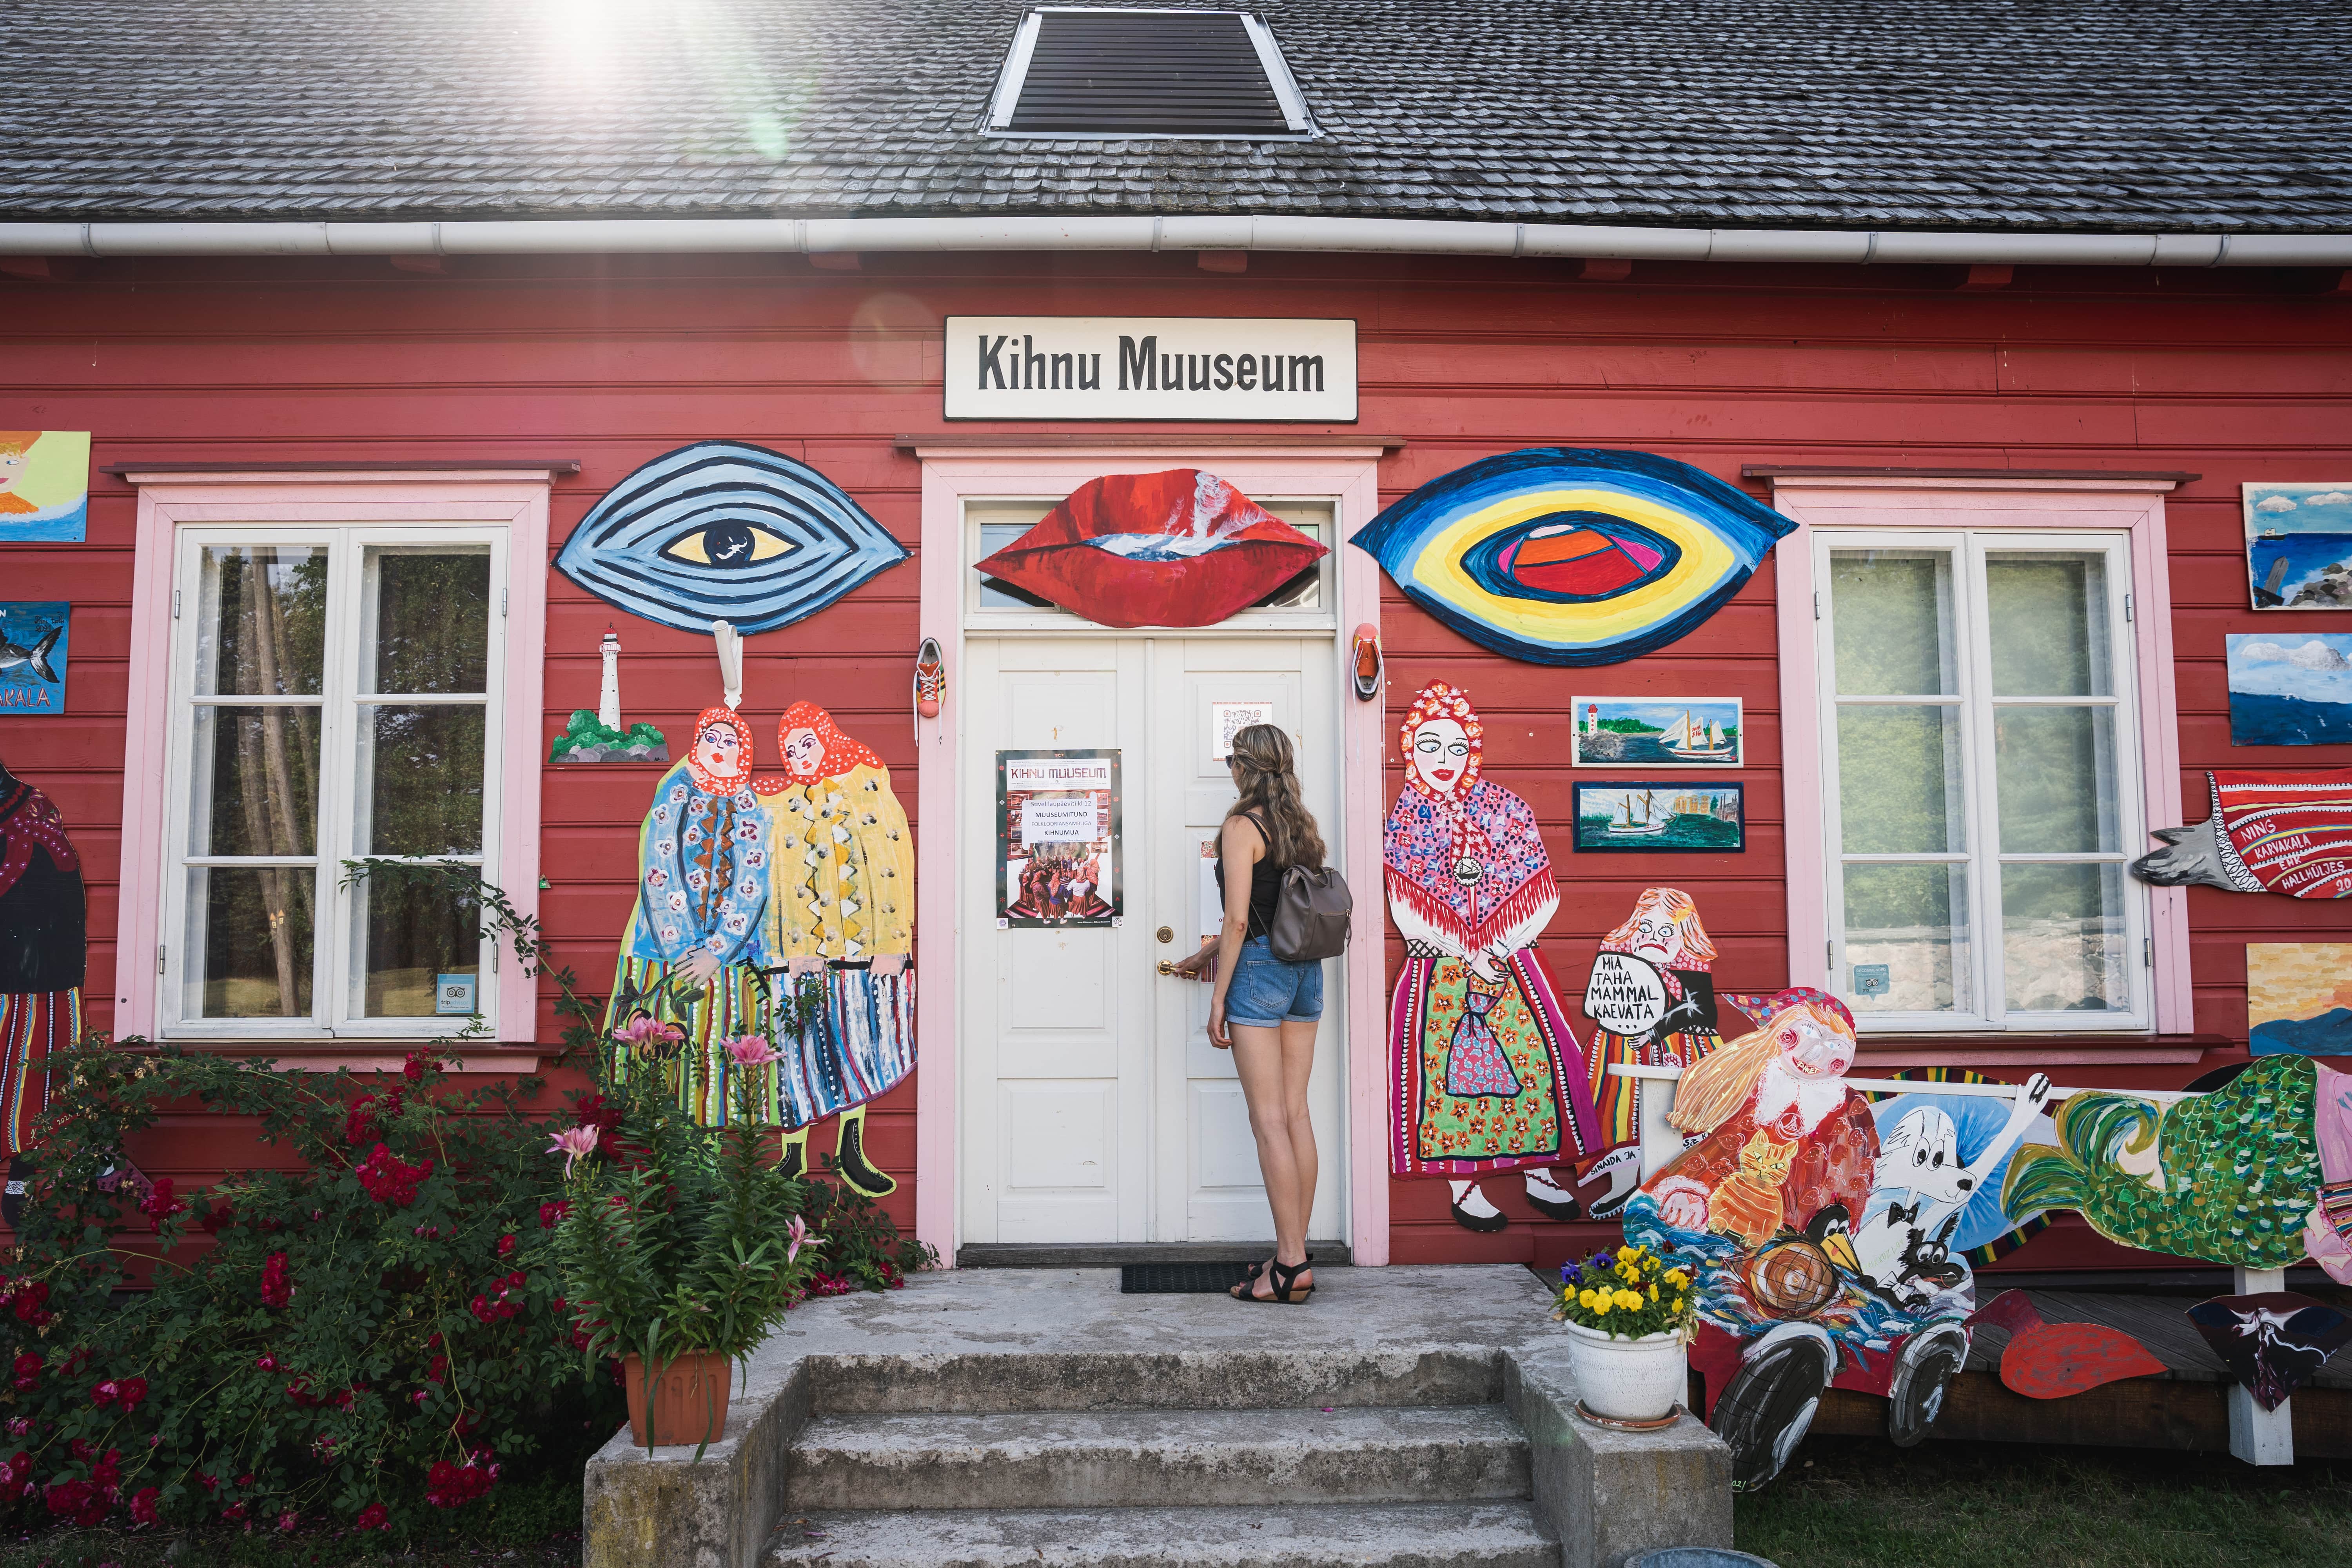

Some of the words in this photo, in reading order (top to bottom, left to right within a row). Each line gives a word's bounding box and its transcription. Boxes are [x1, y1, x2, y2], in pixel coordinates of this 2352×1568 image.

[978, 335, 1101, 390] Kihnu
[1118, 335, 1325, 392] Muuseum
[1011, 768, 1045, 779] KIHNU
[1049, 768, 1107, 779] MUUSEUM
[2240, 819, 2276, 843] NING
[2254, 834, 2311, 860] KARVAKALA
[2279, 855, 2302, 870] EHK
[2282, 861, 2345, 889] HALLHÜLJES
[2336, 877, 2352, 891] 20
[1602, 956, 1623, 971] MIA
[1594, 971, 1633, 986] TAHA
[1591, 985, 1659, 1003] MAMMAL
[1594, 1004, 1655, 1020] KAEVATA
[1797, 1062, 1819, 1073] PIRET
[1591, 1155, 1622, 1175] SINAIDA
[1624, 1151, 1636, 1160] JA
[1731, 1480, 1746, 1490] 021
